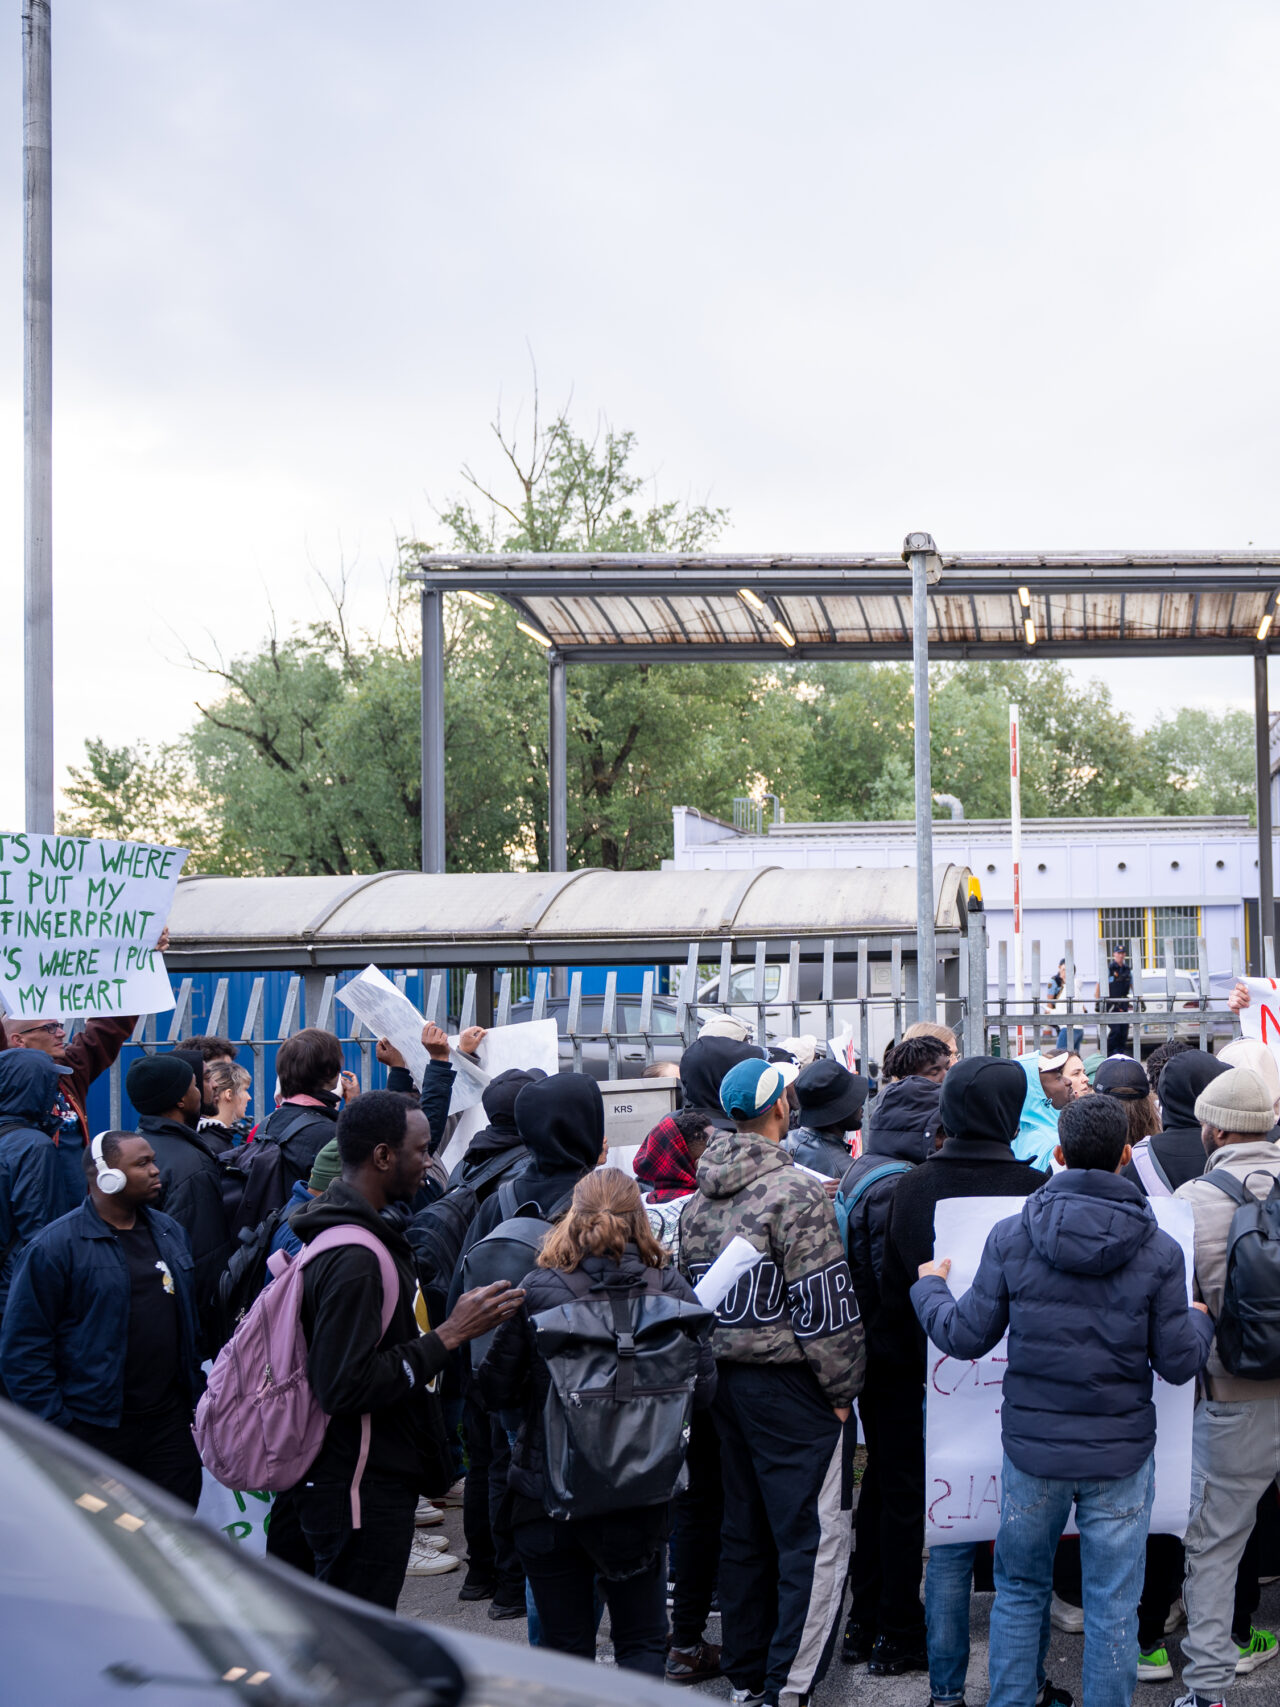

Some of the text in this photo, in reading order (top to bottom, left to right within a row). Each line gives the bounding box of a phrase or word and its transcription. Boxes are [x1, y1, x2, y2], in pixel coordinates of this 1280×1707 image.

[41, 837, 91, 872] NOT
[100, 844, 177, 880] WHERE
[0, 869, 126, 910] I PUT MY
[0, 908, 156, 940] FINGERPRINT
[38, 948, 100, 978] WHERE
[114, 946, 121, 973] I
[126, 945, 156, 973] PUT
[18, 978, 128, 1015] MY HEART
[614, 1105, 633, 1114] KRS
